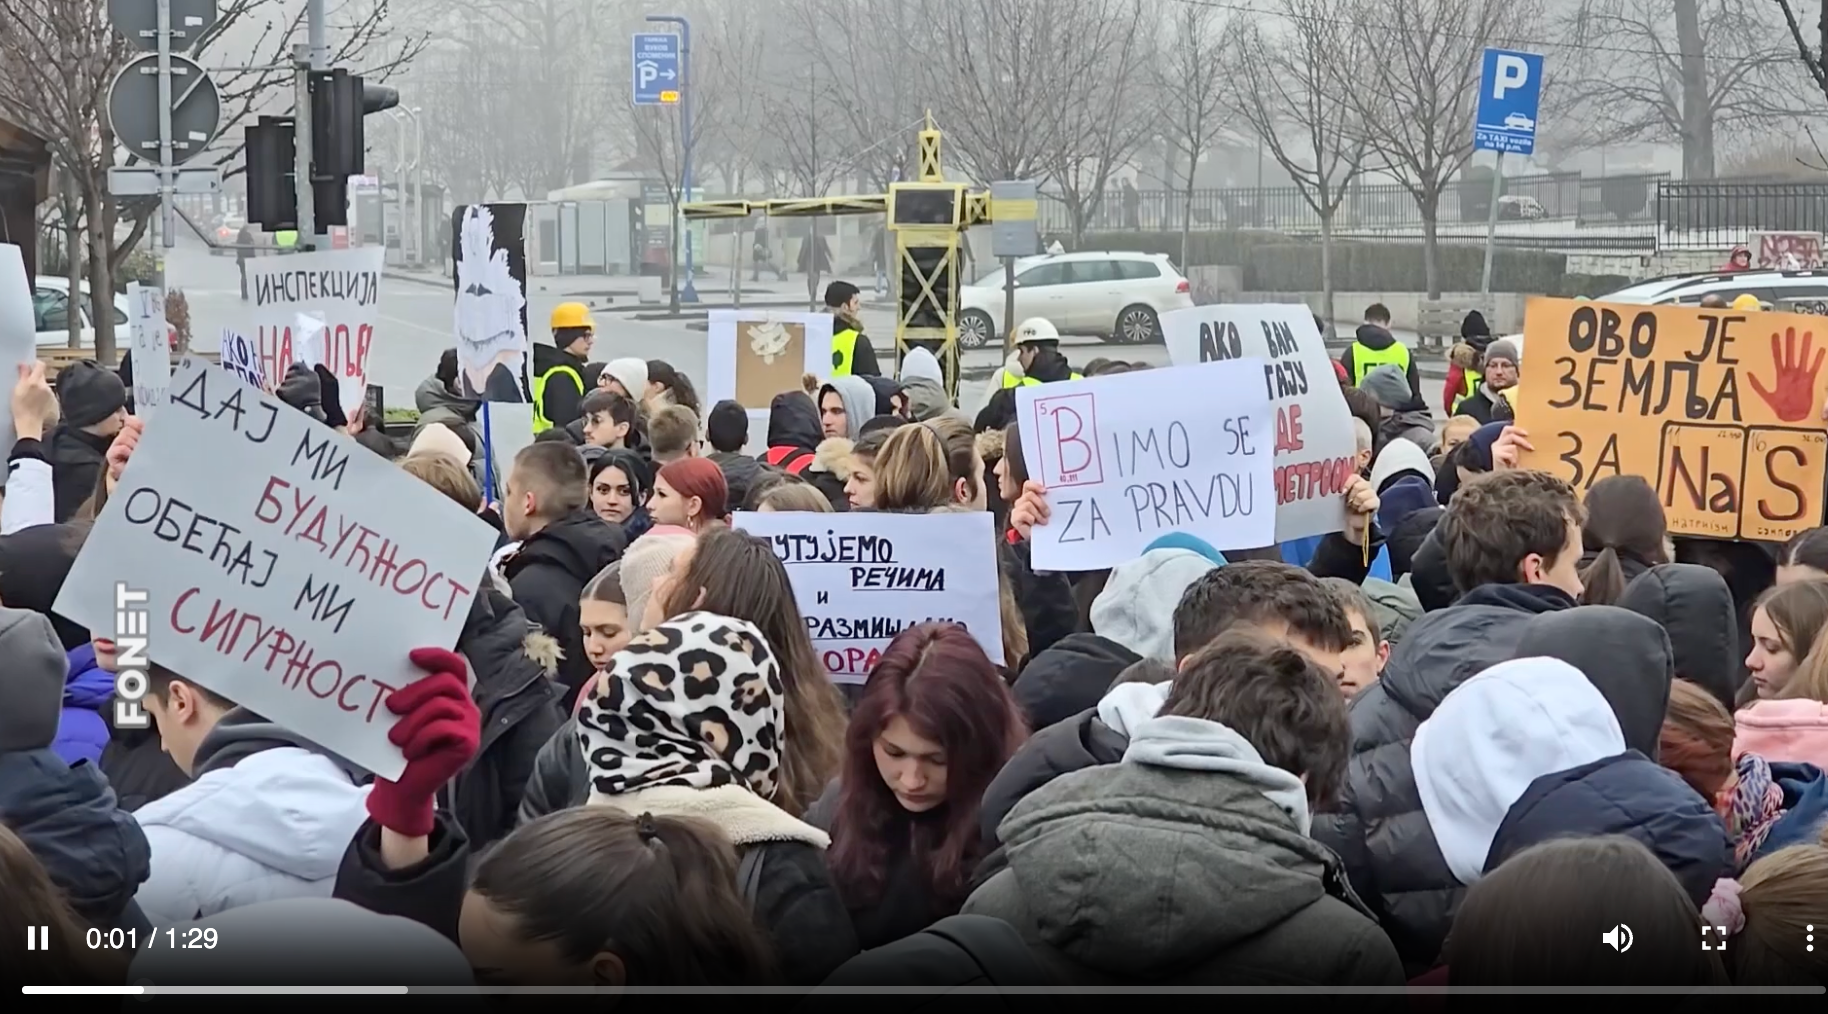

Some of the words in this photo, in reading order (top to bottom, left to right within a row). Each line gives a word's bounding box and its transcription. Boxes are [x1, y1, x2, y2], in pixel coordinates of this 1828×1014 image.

[640, 66, 658, 89] P
[1493, 54, 1528, 100] P
[1489, 134, 1508, 142] TAXI
[255, 270, 377, 307] ИНСПЕКЦИЈА
[1199, 320, 1243, 363] АКО
[1260, 320, 1299, 359] ВАМ
[1568, 305, 1657, 359] ОВО
[1684, 314, 1746, 365] ЈЕ
[1547, 356, 1743, 422] ЗЕМЉА
[291, 428, 350, 491] МИ
[1223, 416, 1256, 456] SE
[1557, 431, 1621, 490] ЗА
[1057, 496, 1112, 544] ZA
[1124, 472, 1253, 533] PRAVDU
[1665, 445, 1738, 514] Na
[1758, 445, 1808, 522] S
[124, 486, 279, 588] ОБЕЋАЈ
[293, 573, 356, 634] МИ
[254, 475, 470, 621] БУДУЋНОСТ
[850, 566, 945, 591] РЕЧИМА
